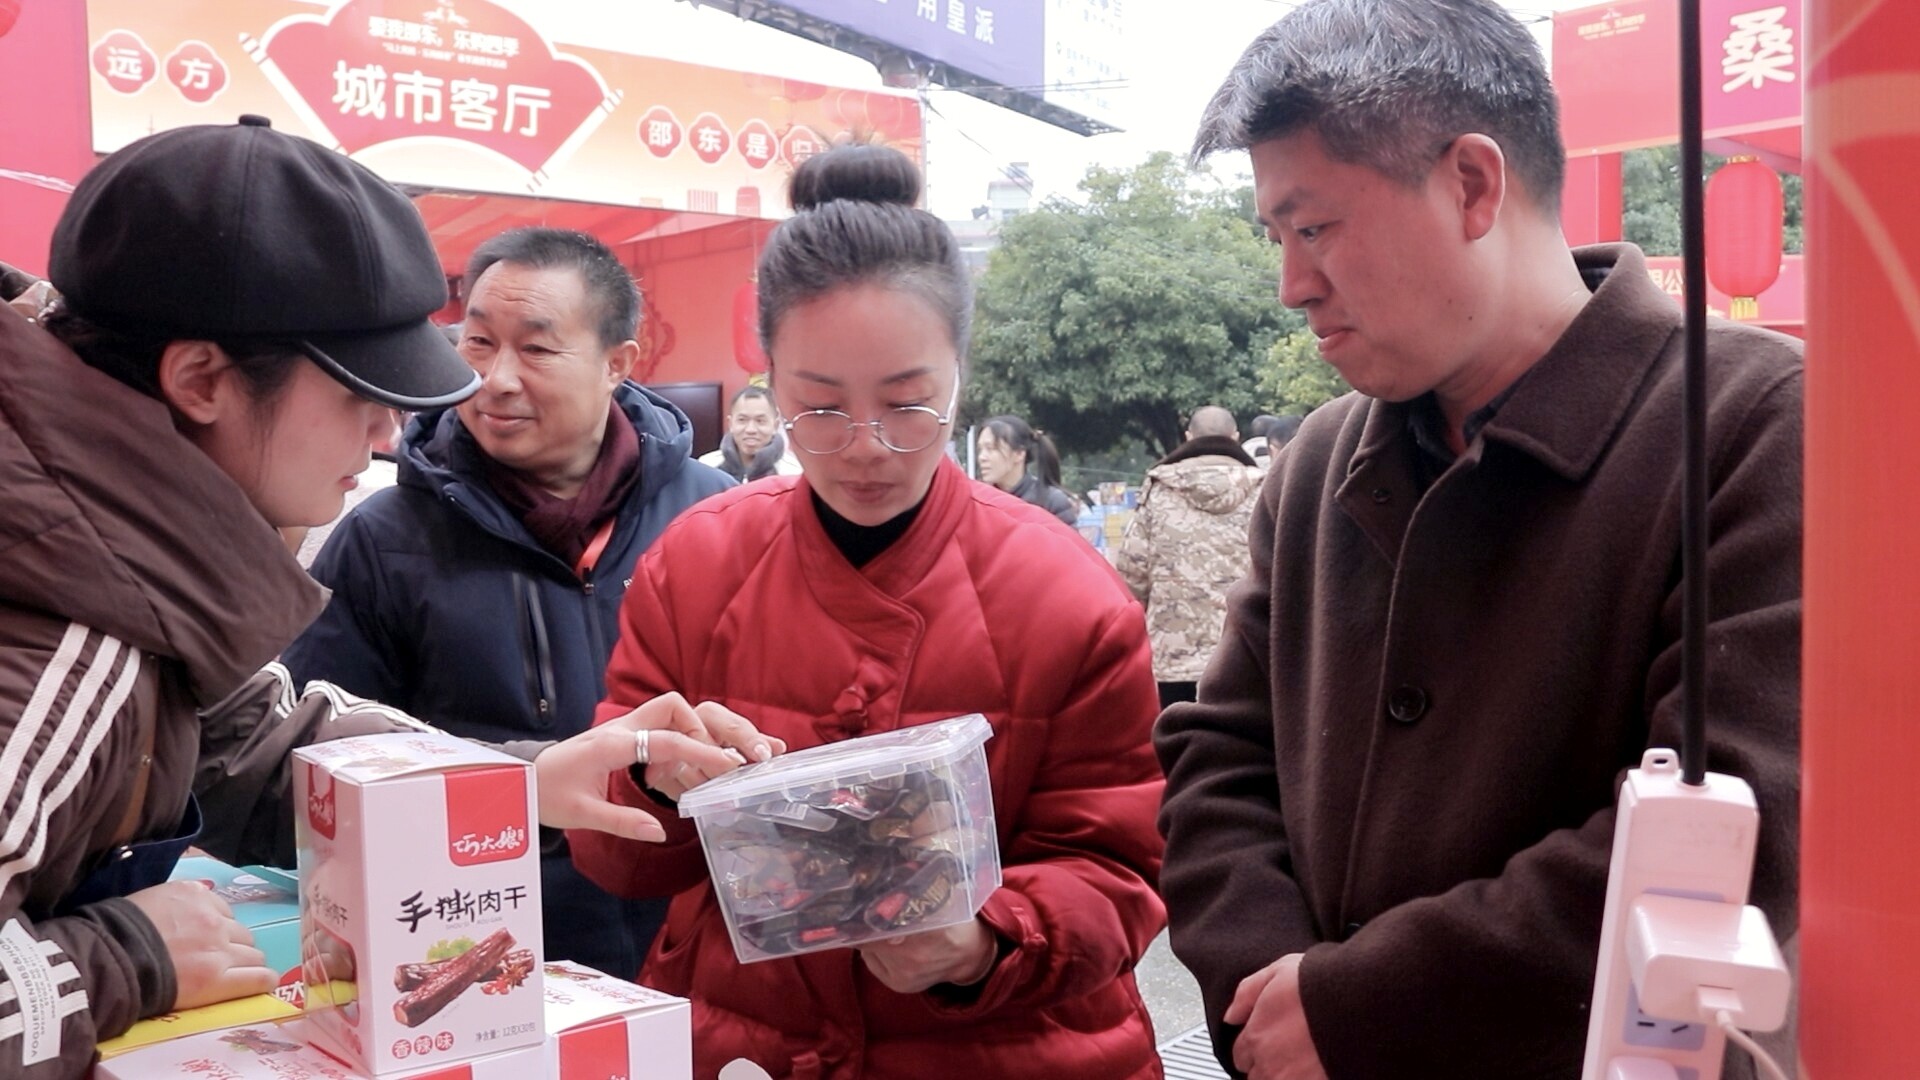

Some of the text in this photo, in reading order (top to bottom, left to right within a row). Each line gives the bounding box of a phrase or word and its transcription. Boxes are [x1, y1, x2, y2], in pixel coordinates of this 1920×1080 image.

[875, 0, 994, 44] 用皇派
[1722, 6, 1796, 94] 桑
[332, 59, 551, 137] 城市客厅
[396, 885, 527, 934] 手撕肉干
[394, 1033, 453, 1058] 香辣味
